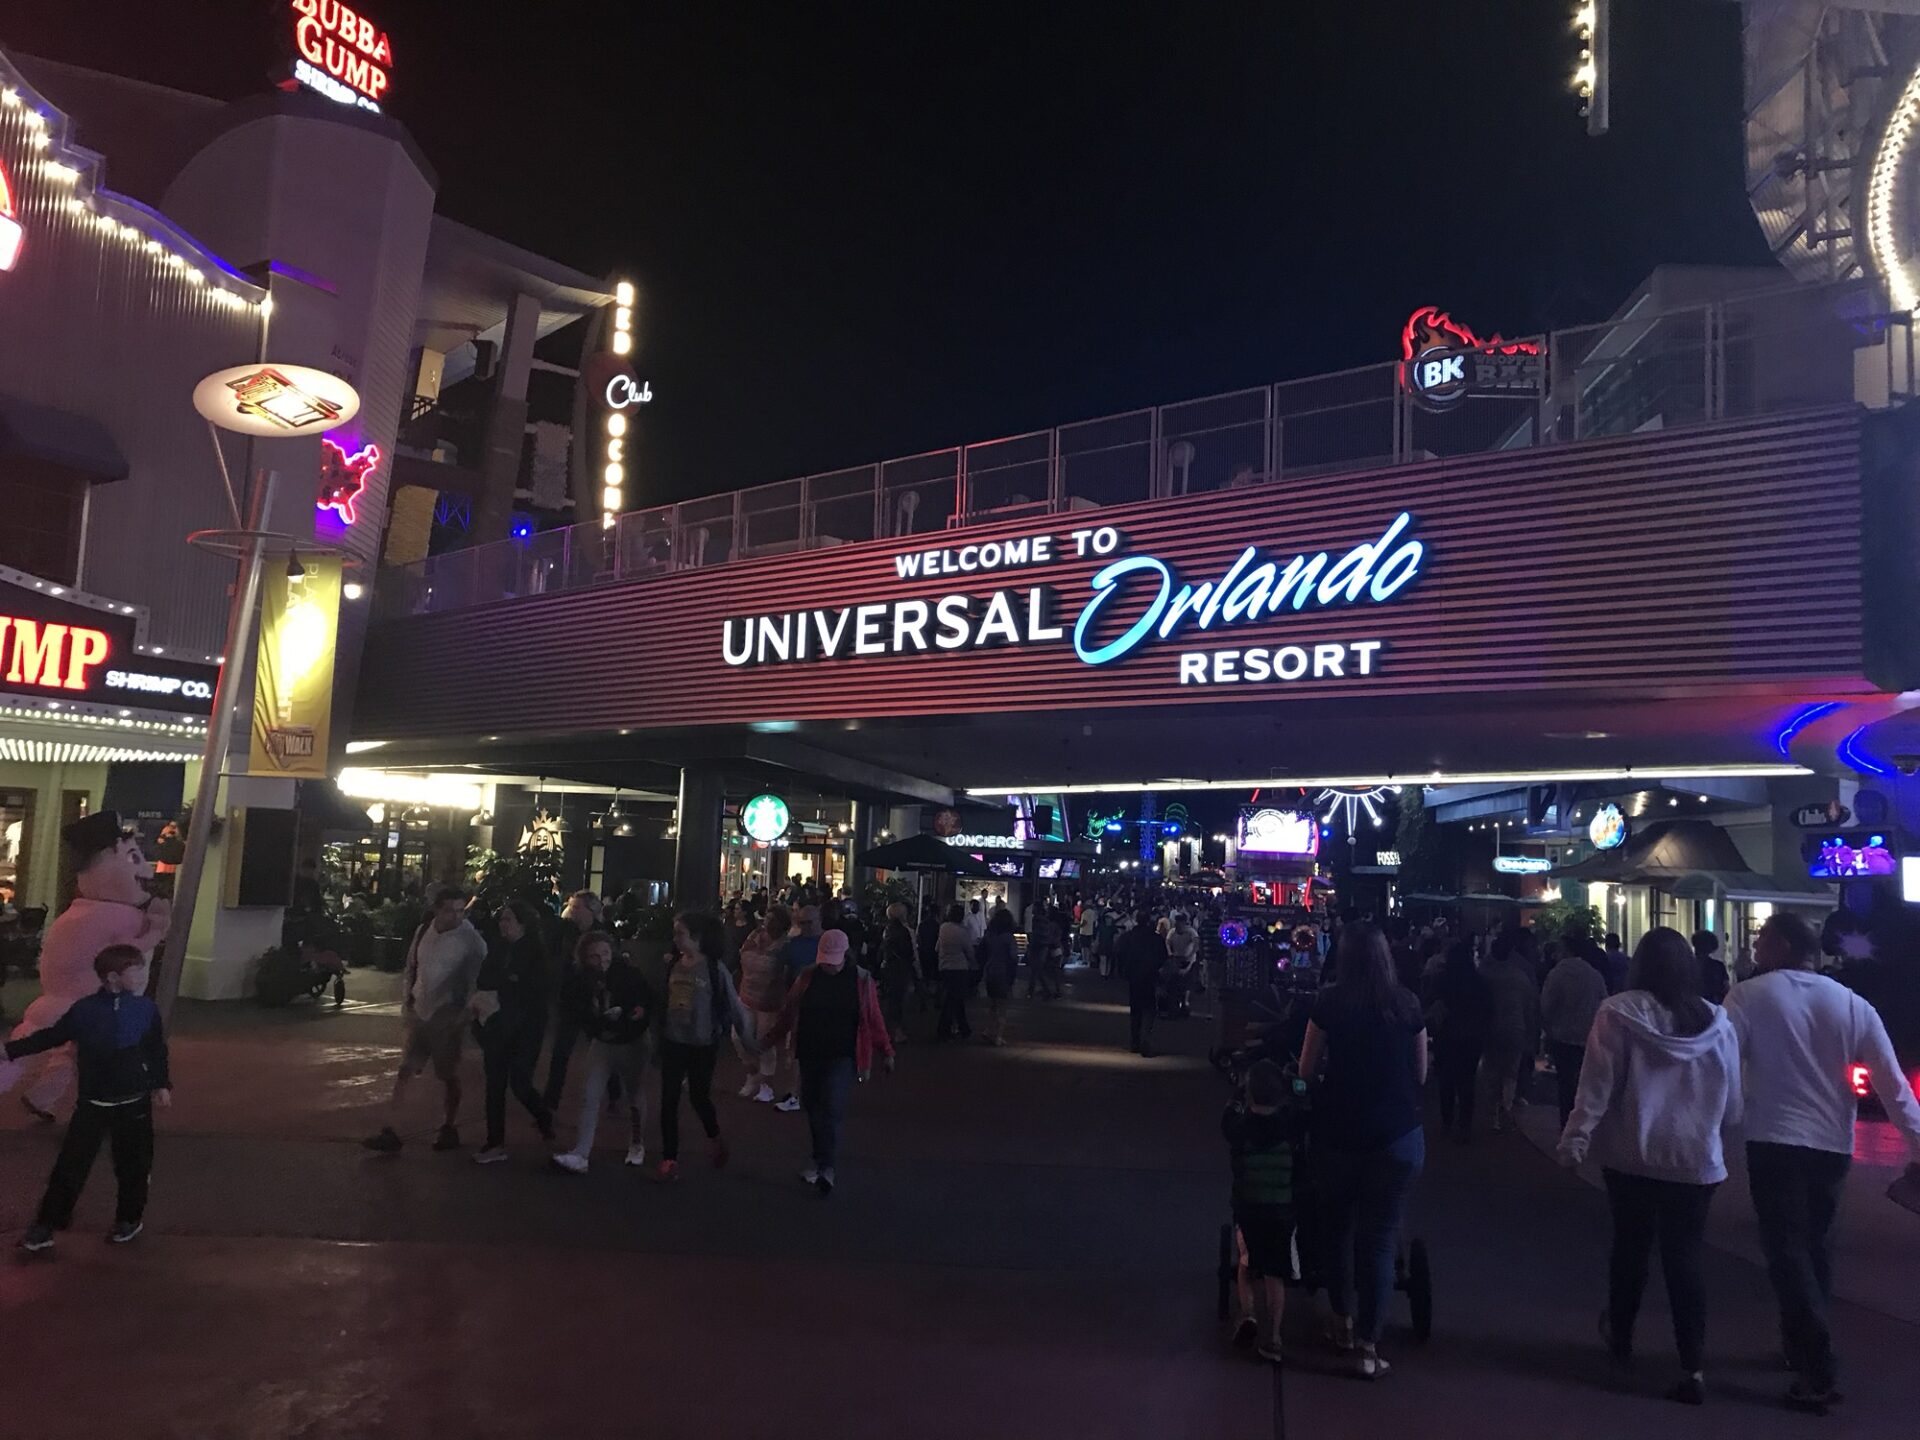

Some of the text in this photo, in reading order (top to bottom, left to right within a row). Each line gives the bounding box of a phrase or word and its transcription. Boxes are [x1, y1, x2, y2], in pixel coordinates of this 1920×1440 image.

[297, 16, 386, 99] GUMP
[606, 374, 652, 409] Club
[1424, 355, 1465, 389] BK
[895, 526, 1118, 580] WELCOME TO
[722, 511, 1424, 666] UNIVERSAL Orlando
[0, 616, 212, 699] MP SHRIMP CO.
[1180, 640, 1381, 684] RESORT
[945, 833, 1025, 849] CONCIERGE
